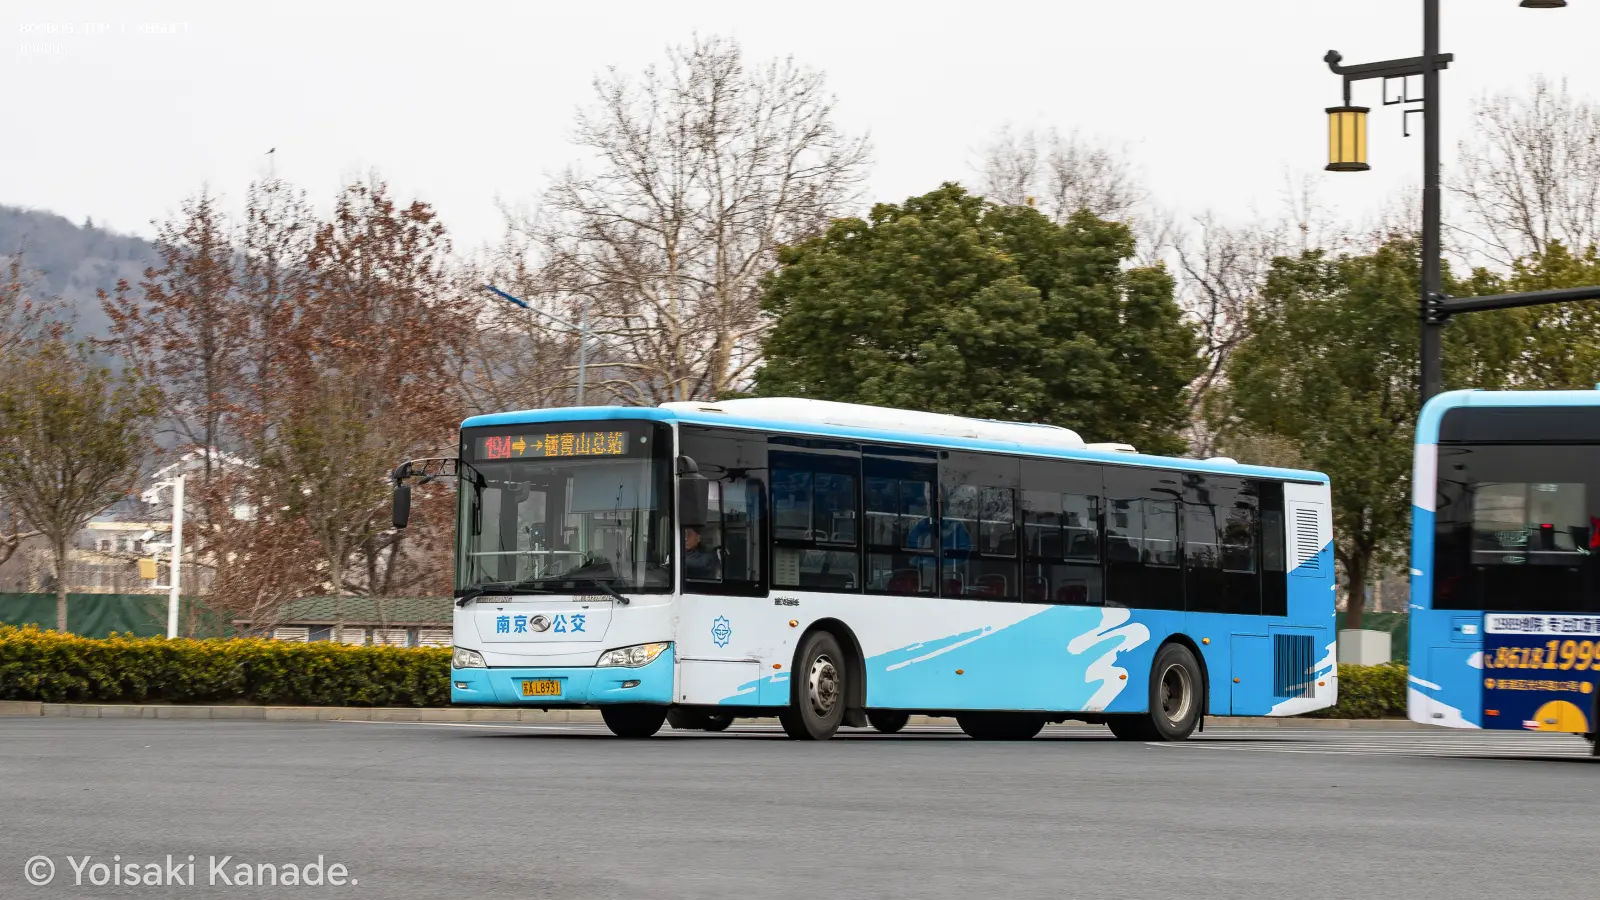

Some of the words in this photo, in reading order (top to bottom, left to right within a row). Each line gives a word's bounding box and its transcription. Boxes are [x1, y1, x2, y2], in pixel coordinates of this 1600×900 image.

[485, 435, 511, 458] 194
[545, 431, 622, 456] 栖霞山总站
[496, 615, 528, 633] 南京
[552, 614, 586, 633] 公交
